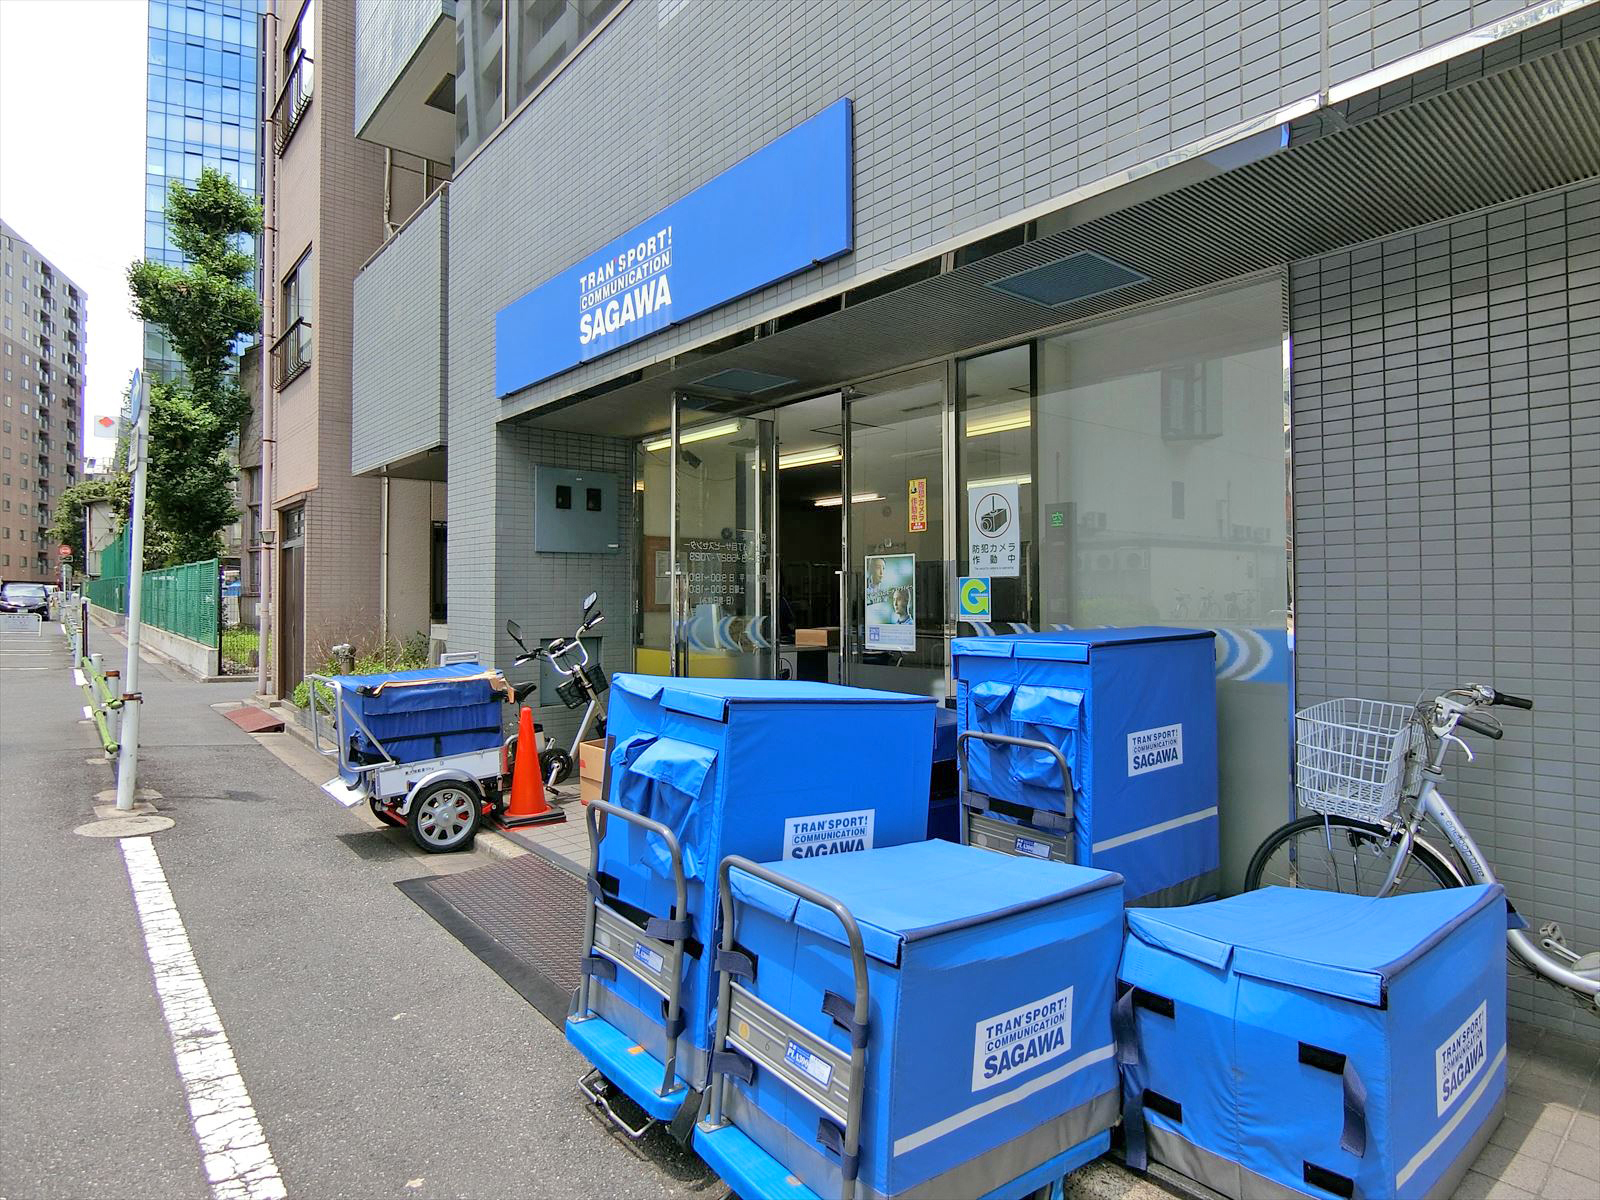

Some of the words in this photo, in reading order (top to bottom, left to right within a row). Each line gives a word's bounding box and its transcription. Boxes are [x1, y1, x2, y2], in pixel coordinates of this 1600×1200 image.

[581, 251, 670, 309] COMMUNICATION
[580, 274, 672, 344] SAGAWA
[972, 542, 1016, 554] 防犯カメラ
[1133, 739, 1177, 753] COMMUNICATION
[1133, 747, 1178, 770] SAGAWA
[792, 839, 865, 859] SAGAWA
[794, 827, 866, 843] COMMUNICATION
[987, 1012, 1065, 1051] COMMUNICATION
[984, 1026, 1064, 1079] SAGAWA
[1442, 1040, 1484, 1102] SAGAWA
[1443, 1028, 1483, 1075] COMMUNICATION
